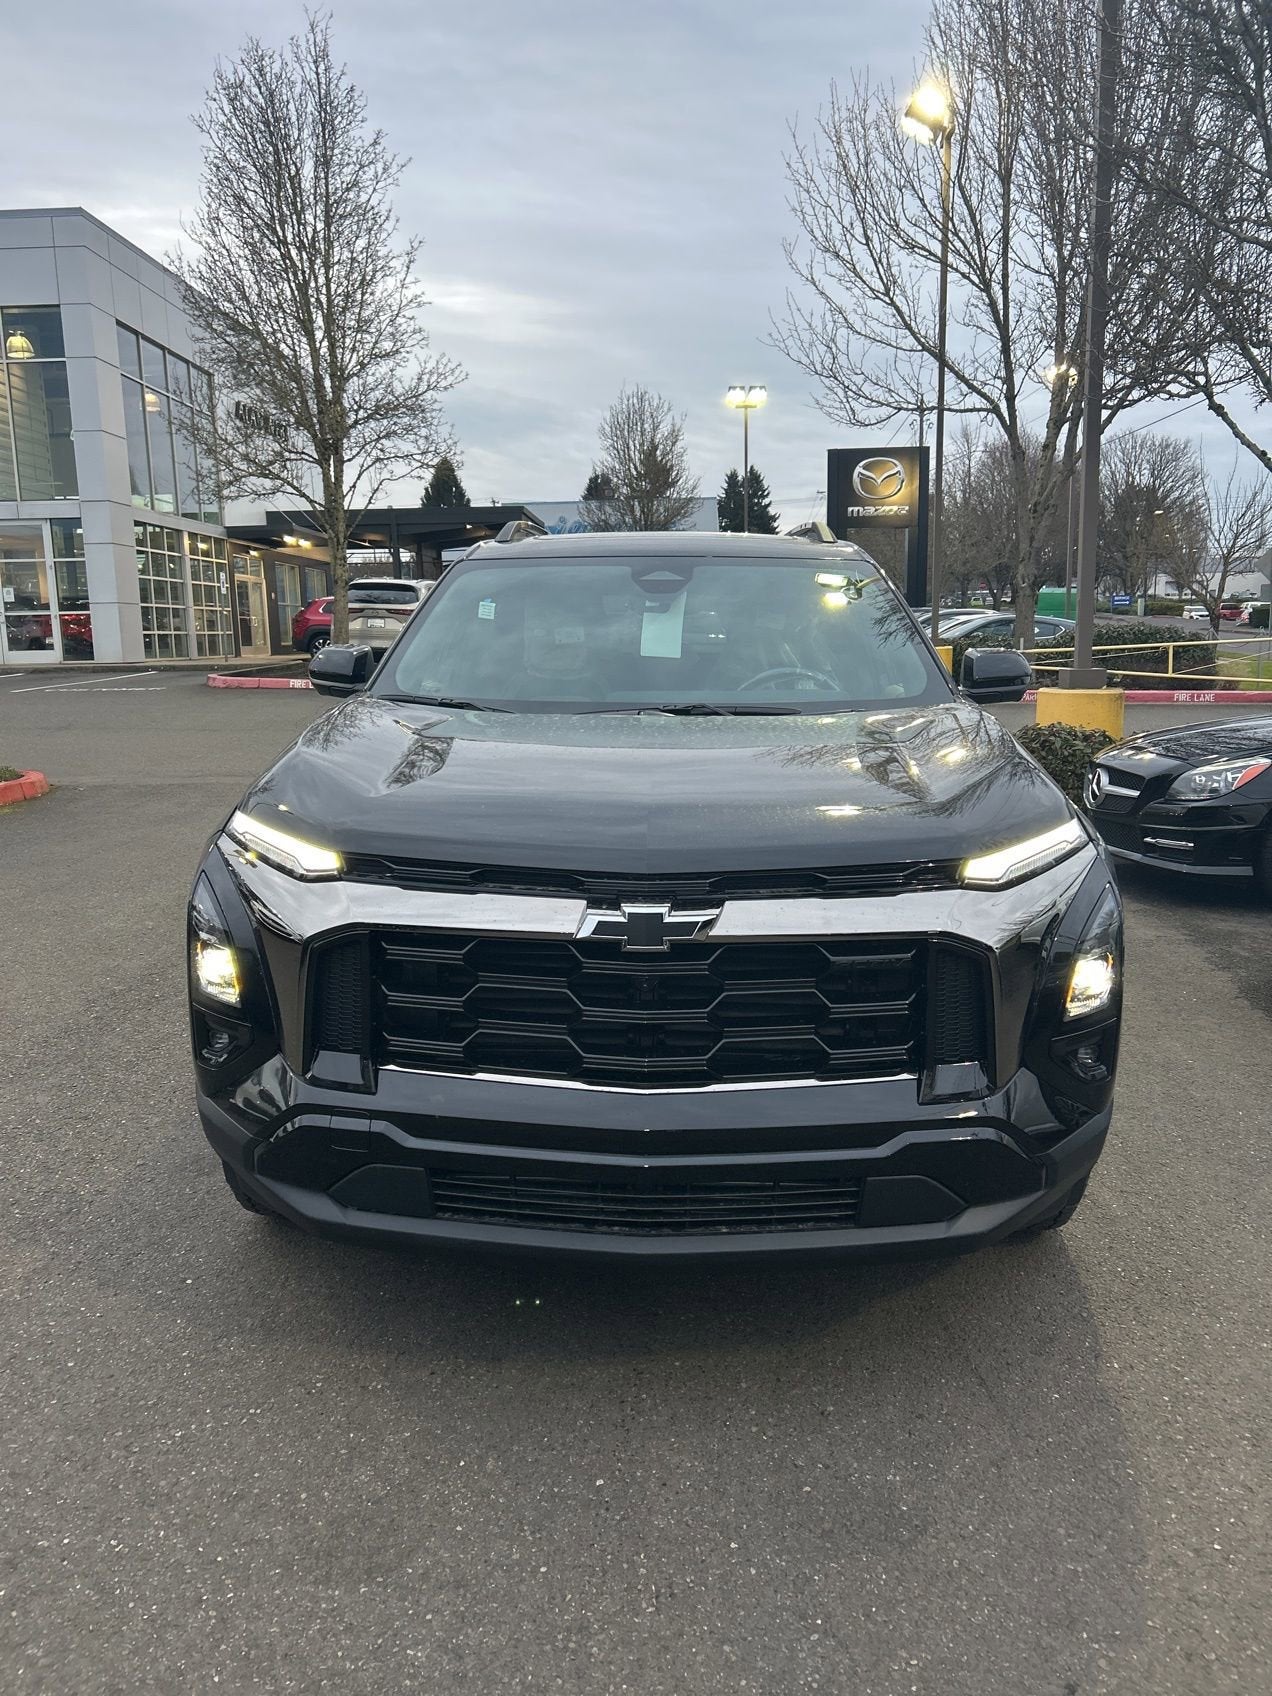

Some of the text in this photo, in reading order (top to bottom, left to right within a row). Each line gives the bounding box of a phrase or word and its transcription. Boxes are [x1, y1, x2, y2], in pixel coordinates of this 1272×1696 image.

[289, 680, 307, 689] FIRE
[1174, 693, 1216, 702] FIRE LANE
